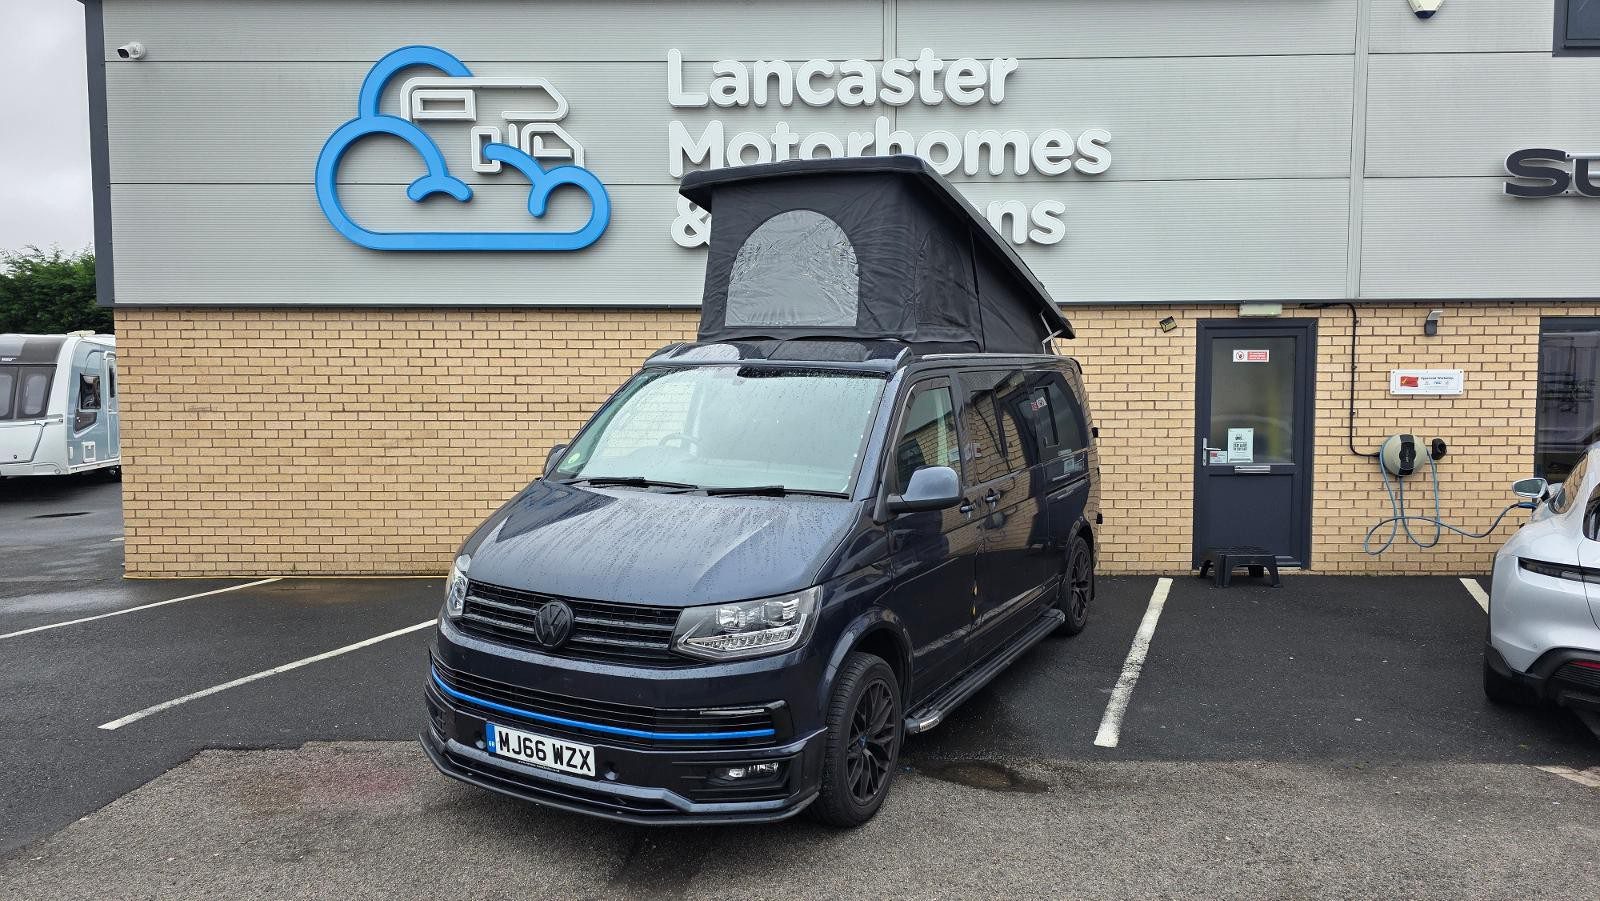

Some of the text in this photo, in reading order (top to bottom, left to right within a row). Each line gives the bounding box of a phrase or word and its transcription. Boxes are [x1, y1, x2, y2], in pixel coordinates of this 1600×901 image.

[668, 48, 1018, 107] Lancaster
[668, 116, 1112, 177] Motorhomes
[498, 730, 591, 772] MJ66 WZX
